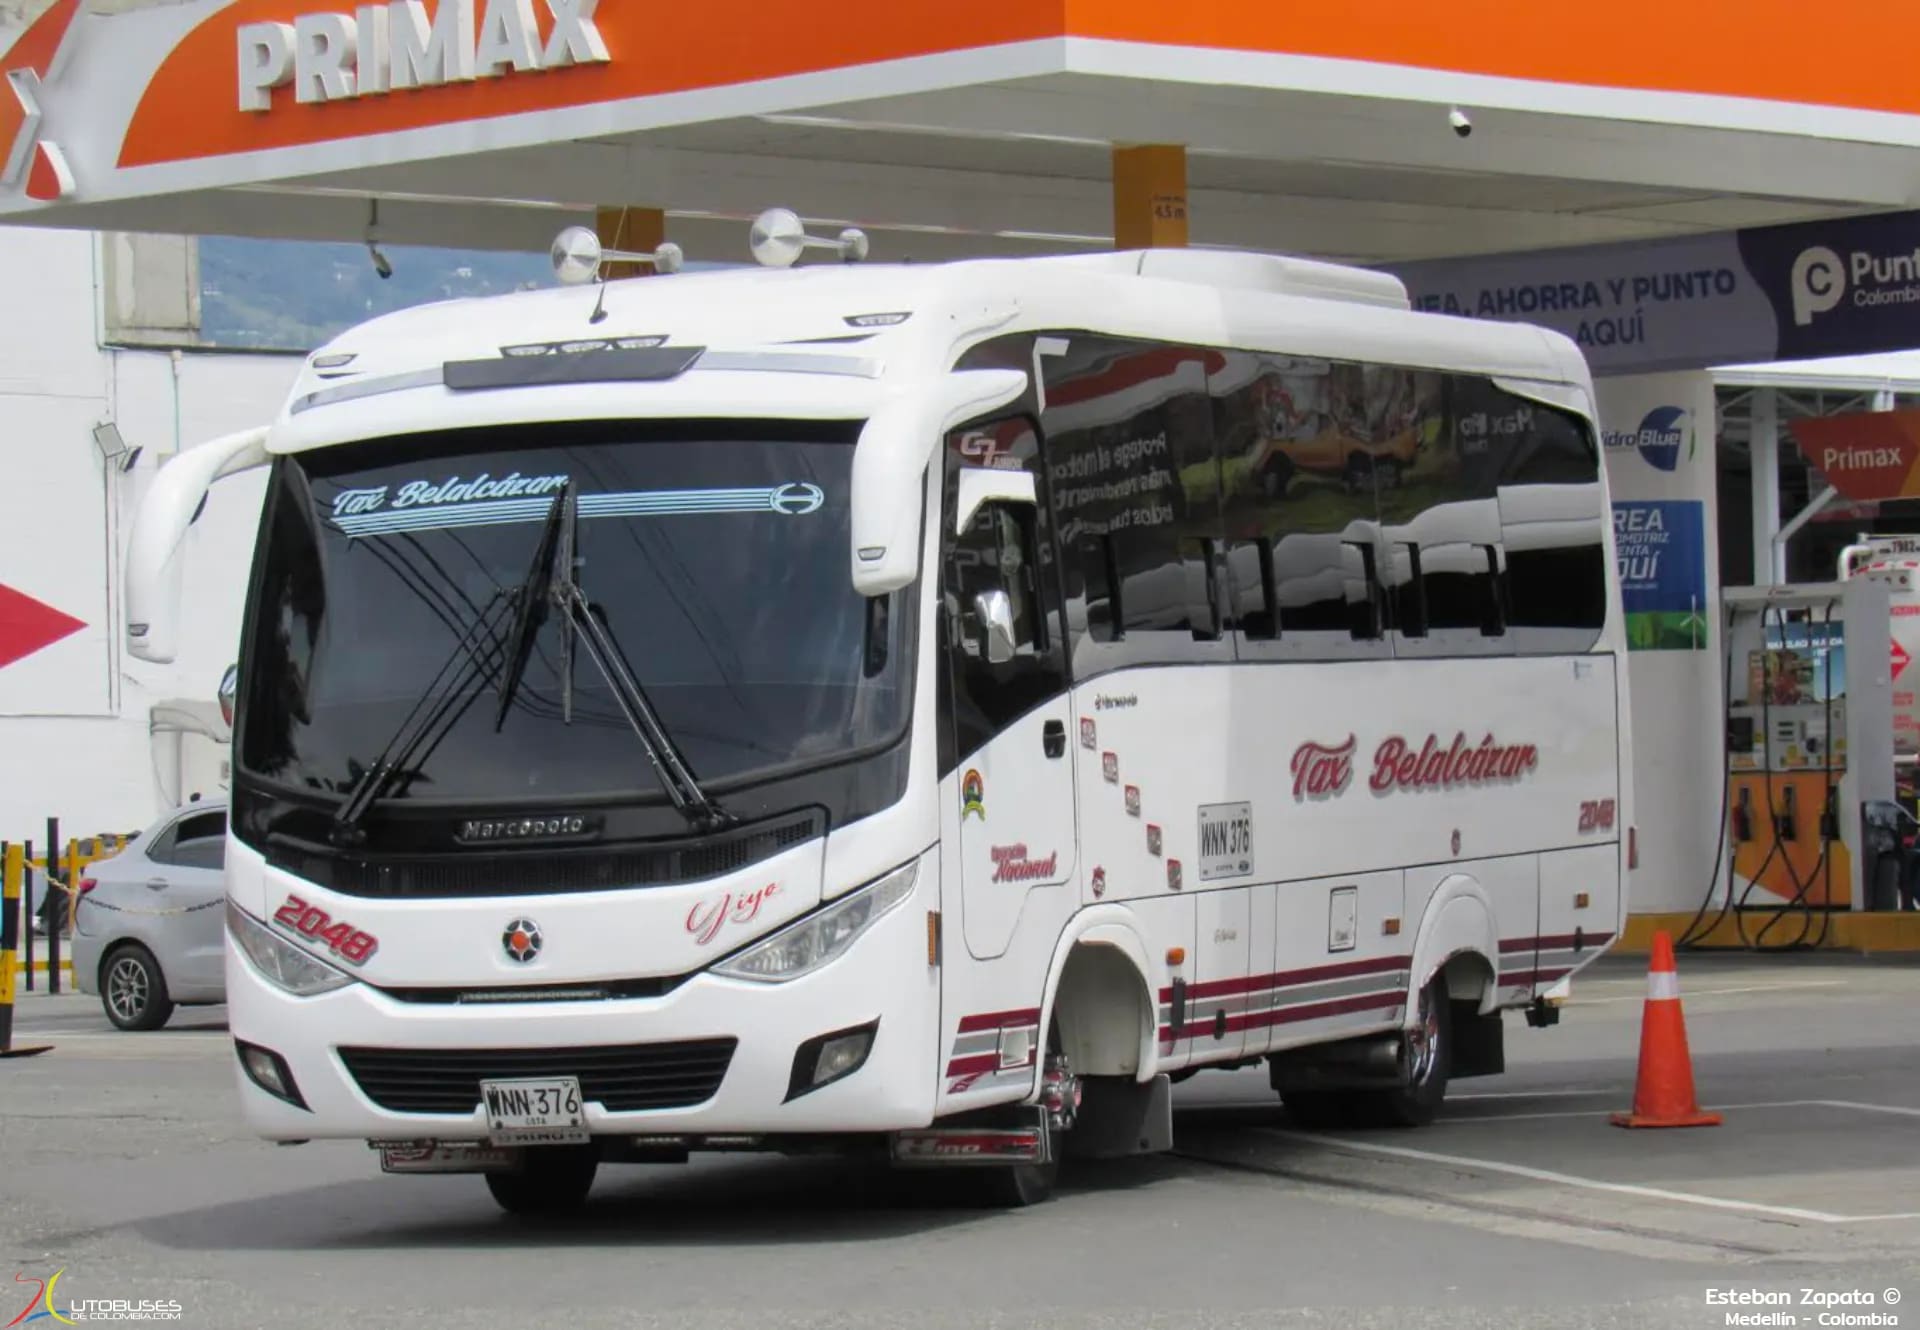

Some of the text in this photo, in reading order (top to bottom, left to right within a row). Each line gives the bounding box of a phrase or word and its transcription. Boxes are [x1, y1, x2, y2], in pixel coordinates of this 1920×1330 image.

[237, 0, 611, 112] PRIMAX
[1477, 282, 1603, 316] AHORRA
[1603, 278, 1626, 305] Y
[1633, 267, 1736, 303] PUNTO
[1575, 309, 1645, 346] AQUÍ
[1823, 447, 1903, 472] Primax
[333, 472, 569, 515] Tax Belalcázar
[1290, 731, 1537, 800] Tax Belalcázar
[462, 816, 585, 840] Marcopolo
[1201, 818, 1250, 857] WNN 376
[273, 894, 379, 967] 2048
